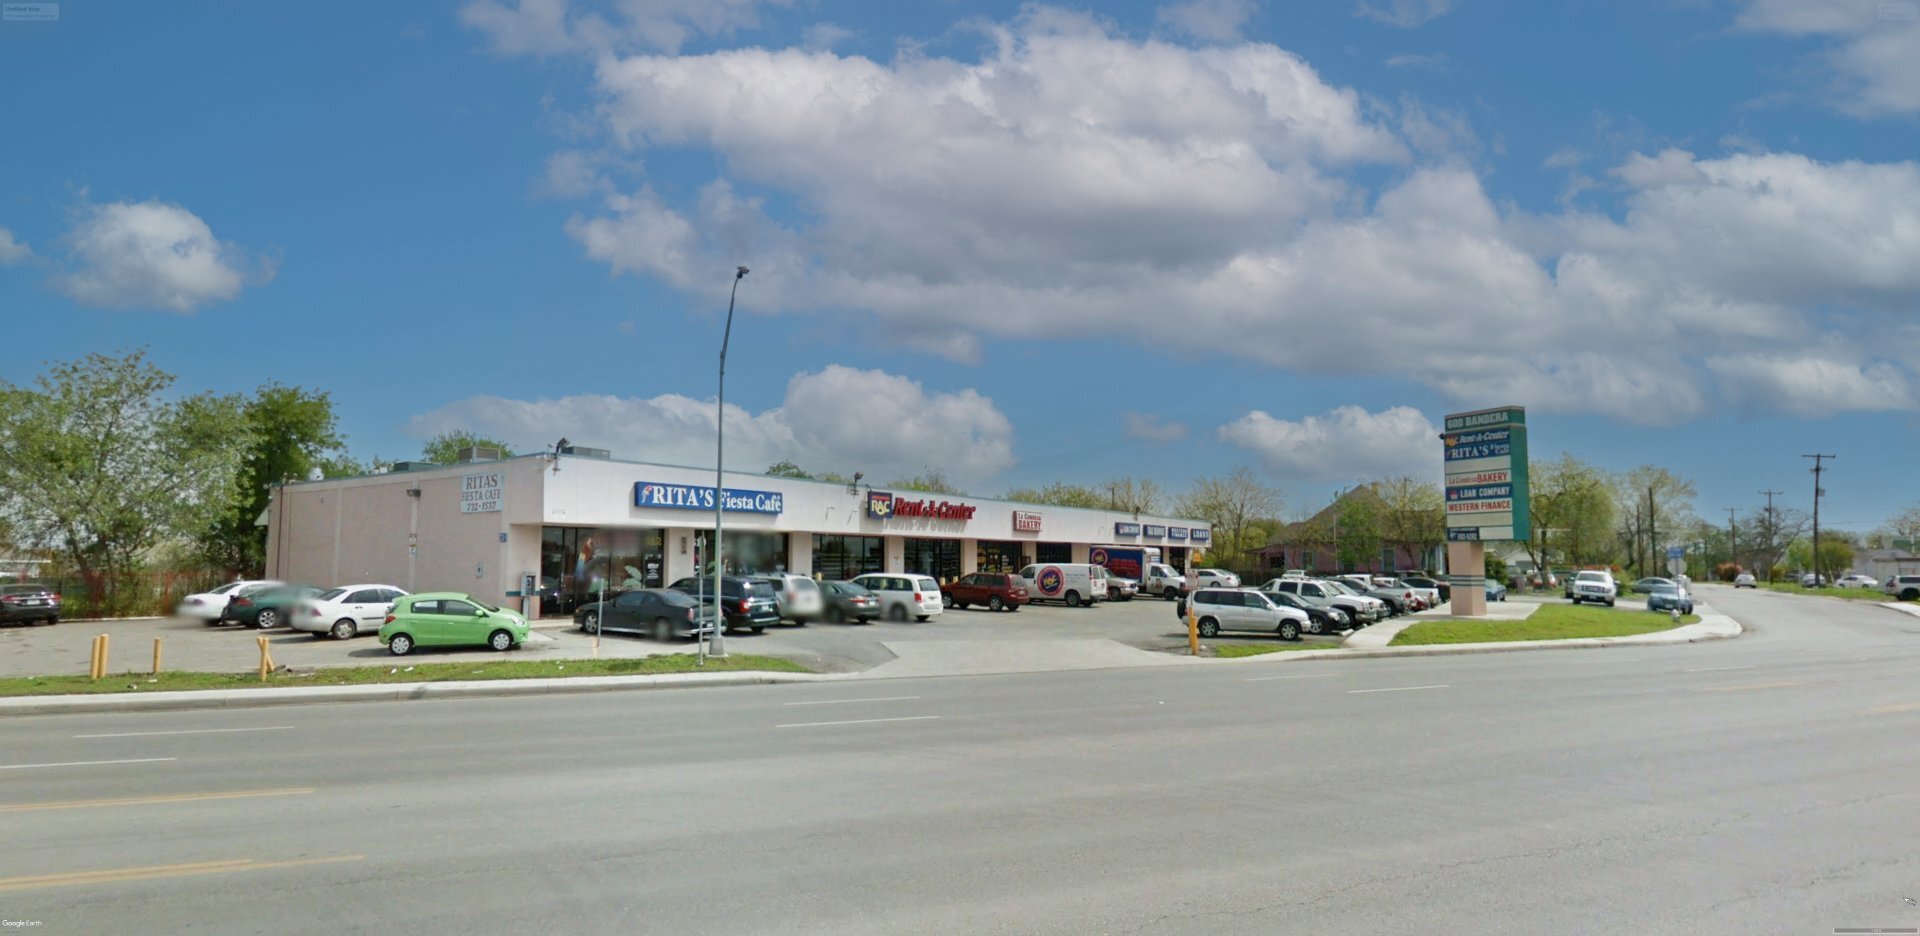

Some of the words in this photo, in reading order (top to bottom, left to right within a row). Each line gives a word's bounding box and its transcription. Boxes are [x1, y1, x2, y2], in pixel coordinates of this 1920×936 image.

[1465, 412, 1509, 426] BANDERA
[1459, 431, 1509, 444] Rent-A-Center
[1451, 444, 1490, 458] RITA'S
[466, 474, 498, 490] RITA'S
[1477, 472, 1508, 483] BAKERY
[462, 491, 483, 501] FIESTA
[652, 485, 714, 508] RITA'S
[720, 491, 754, 510] Fiesta
[755, 494, 782, 512] Café
[1460, 488, 1477, 498] LOAN
[1479, 486, 1510, 496] COMPANY
[871, 500, 890, 516] RAC
[893, 497, 977, 520] Rent-A-Center
[1448, 502, 1479, 512] WESTERN
[1481, 500, 1511, 510] FINANCE
[1018, 519, 1042, 531] BAKERY
[1193, 529, 1209, 539] LOANS
